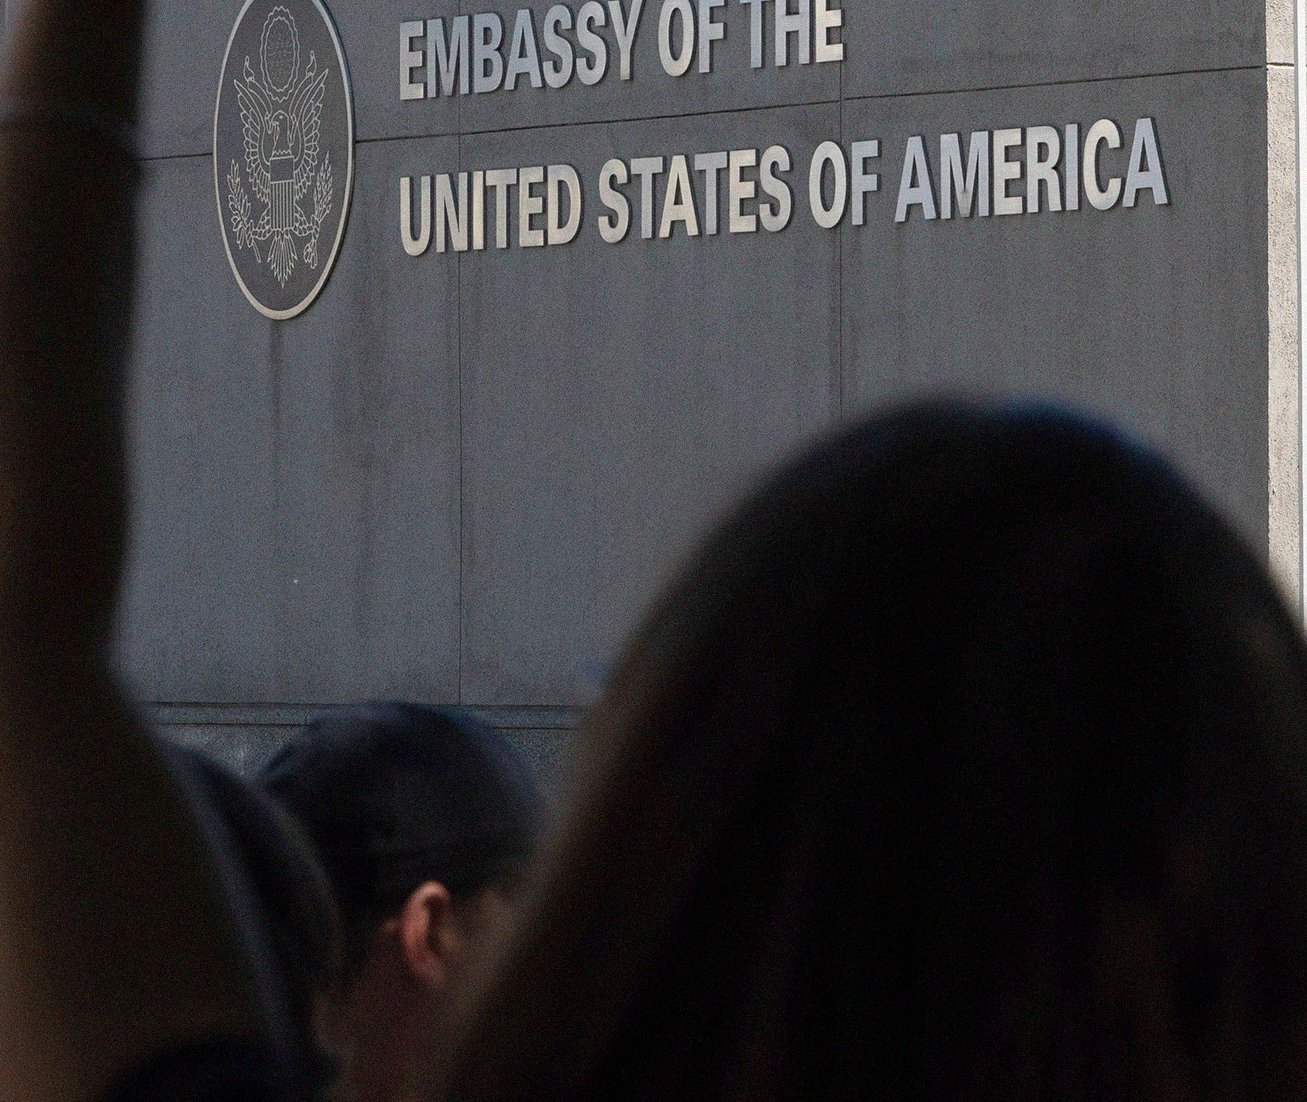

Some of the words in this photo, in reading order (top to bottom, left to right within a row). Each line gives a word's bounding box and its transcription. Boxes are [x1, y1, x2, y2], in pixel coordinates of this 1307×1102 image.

[399, 164, 583, 257] UNITED
[598, 144, 793, 244] STATES
[808, 139, 881, 229] OF
[894, 116, 1169, 223] AMERICA
